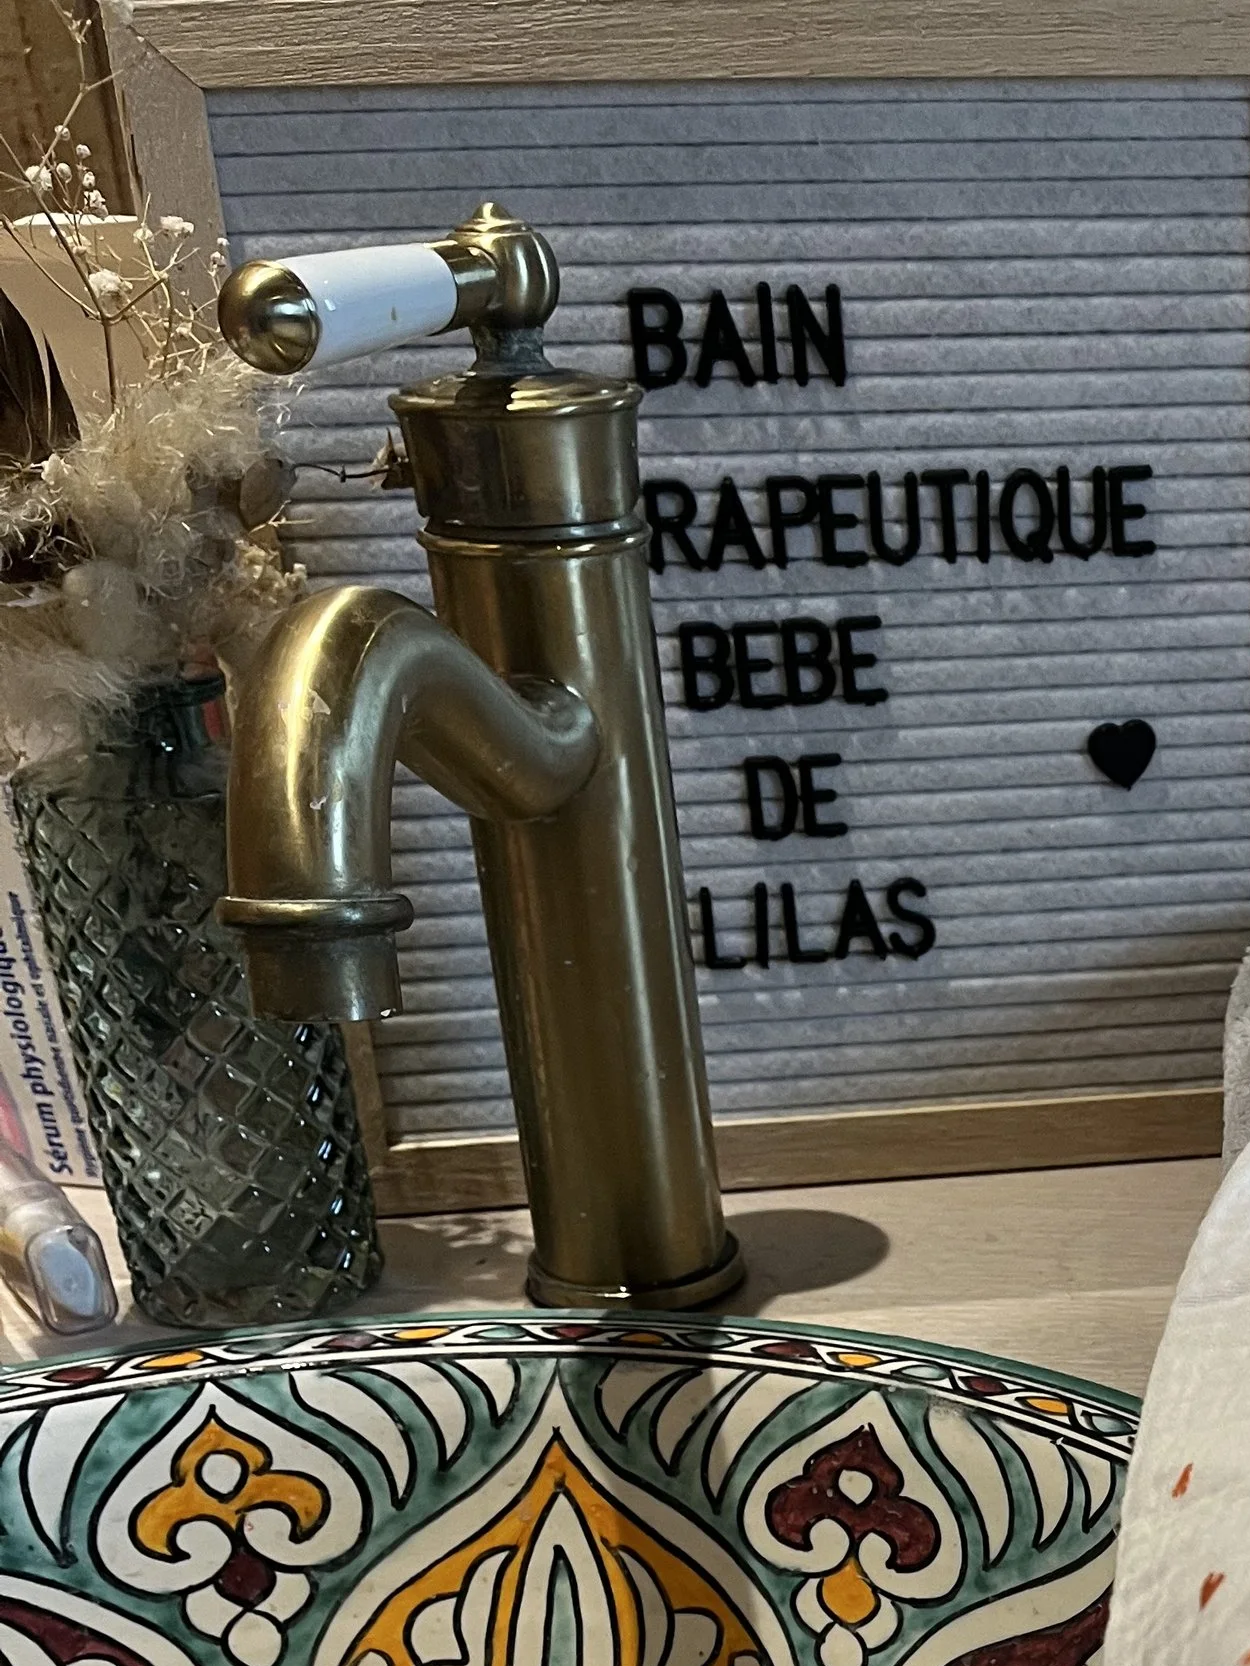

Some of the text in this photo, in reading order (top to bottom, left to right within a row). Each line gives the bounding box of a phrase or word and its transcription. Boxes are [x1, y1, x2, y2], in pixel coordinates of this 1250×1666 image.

[625, 282, 847, 390] BAIN
[642, 464, 1158, 575] RAPEUTIQUE
[677, 615, 890, 711] BEBE
[744, 753, 849, 840] DE
[698, 878, 936, 970] LILAS
[0, 926, 74, 1176] Sérum physiologiq
